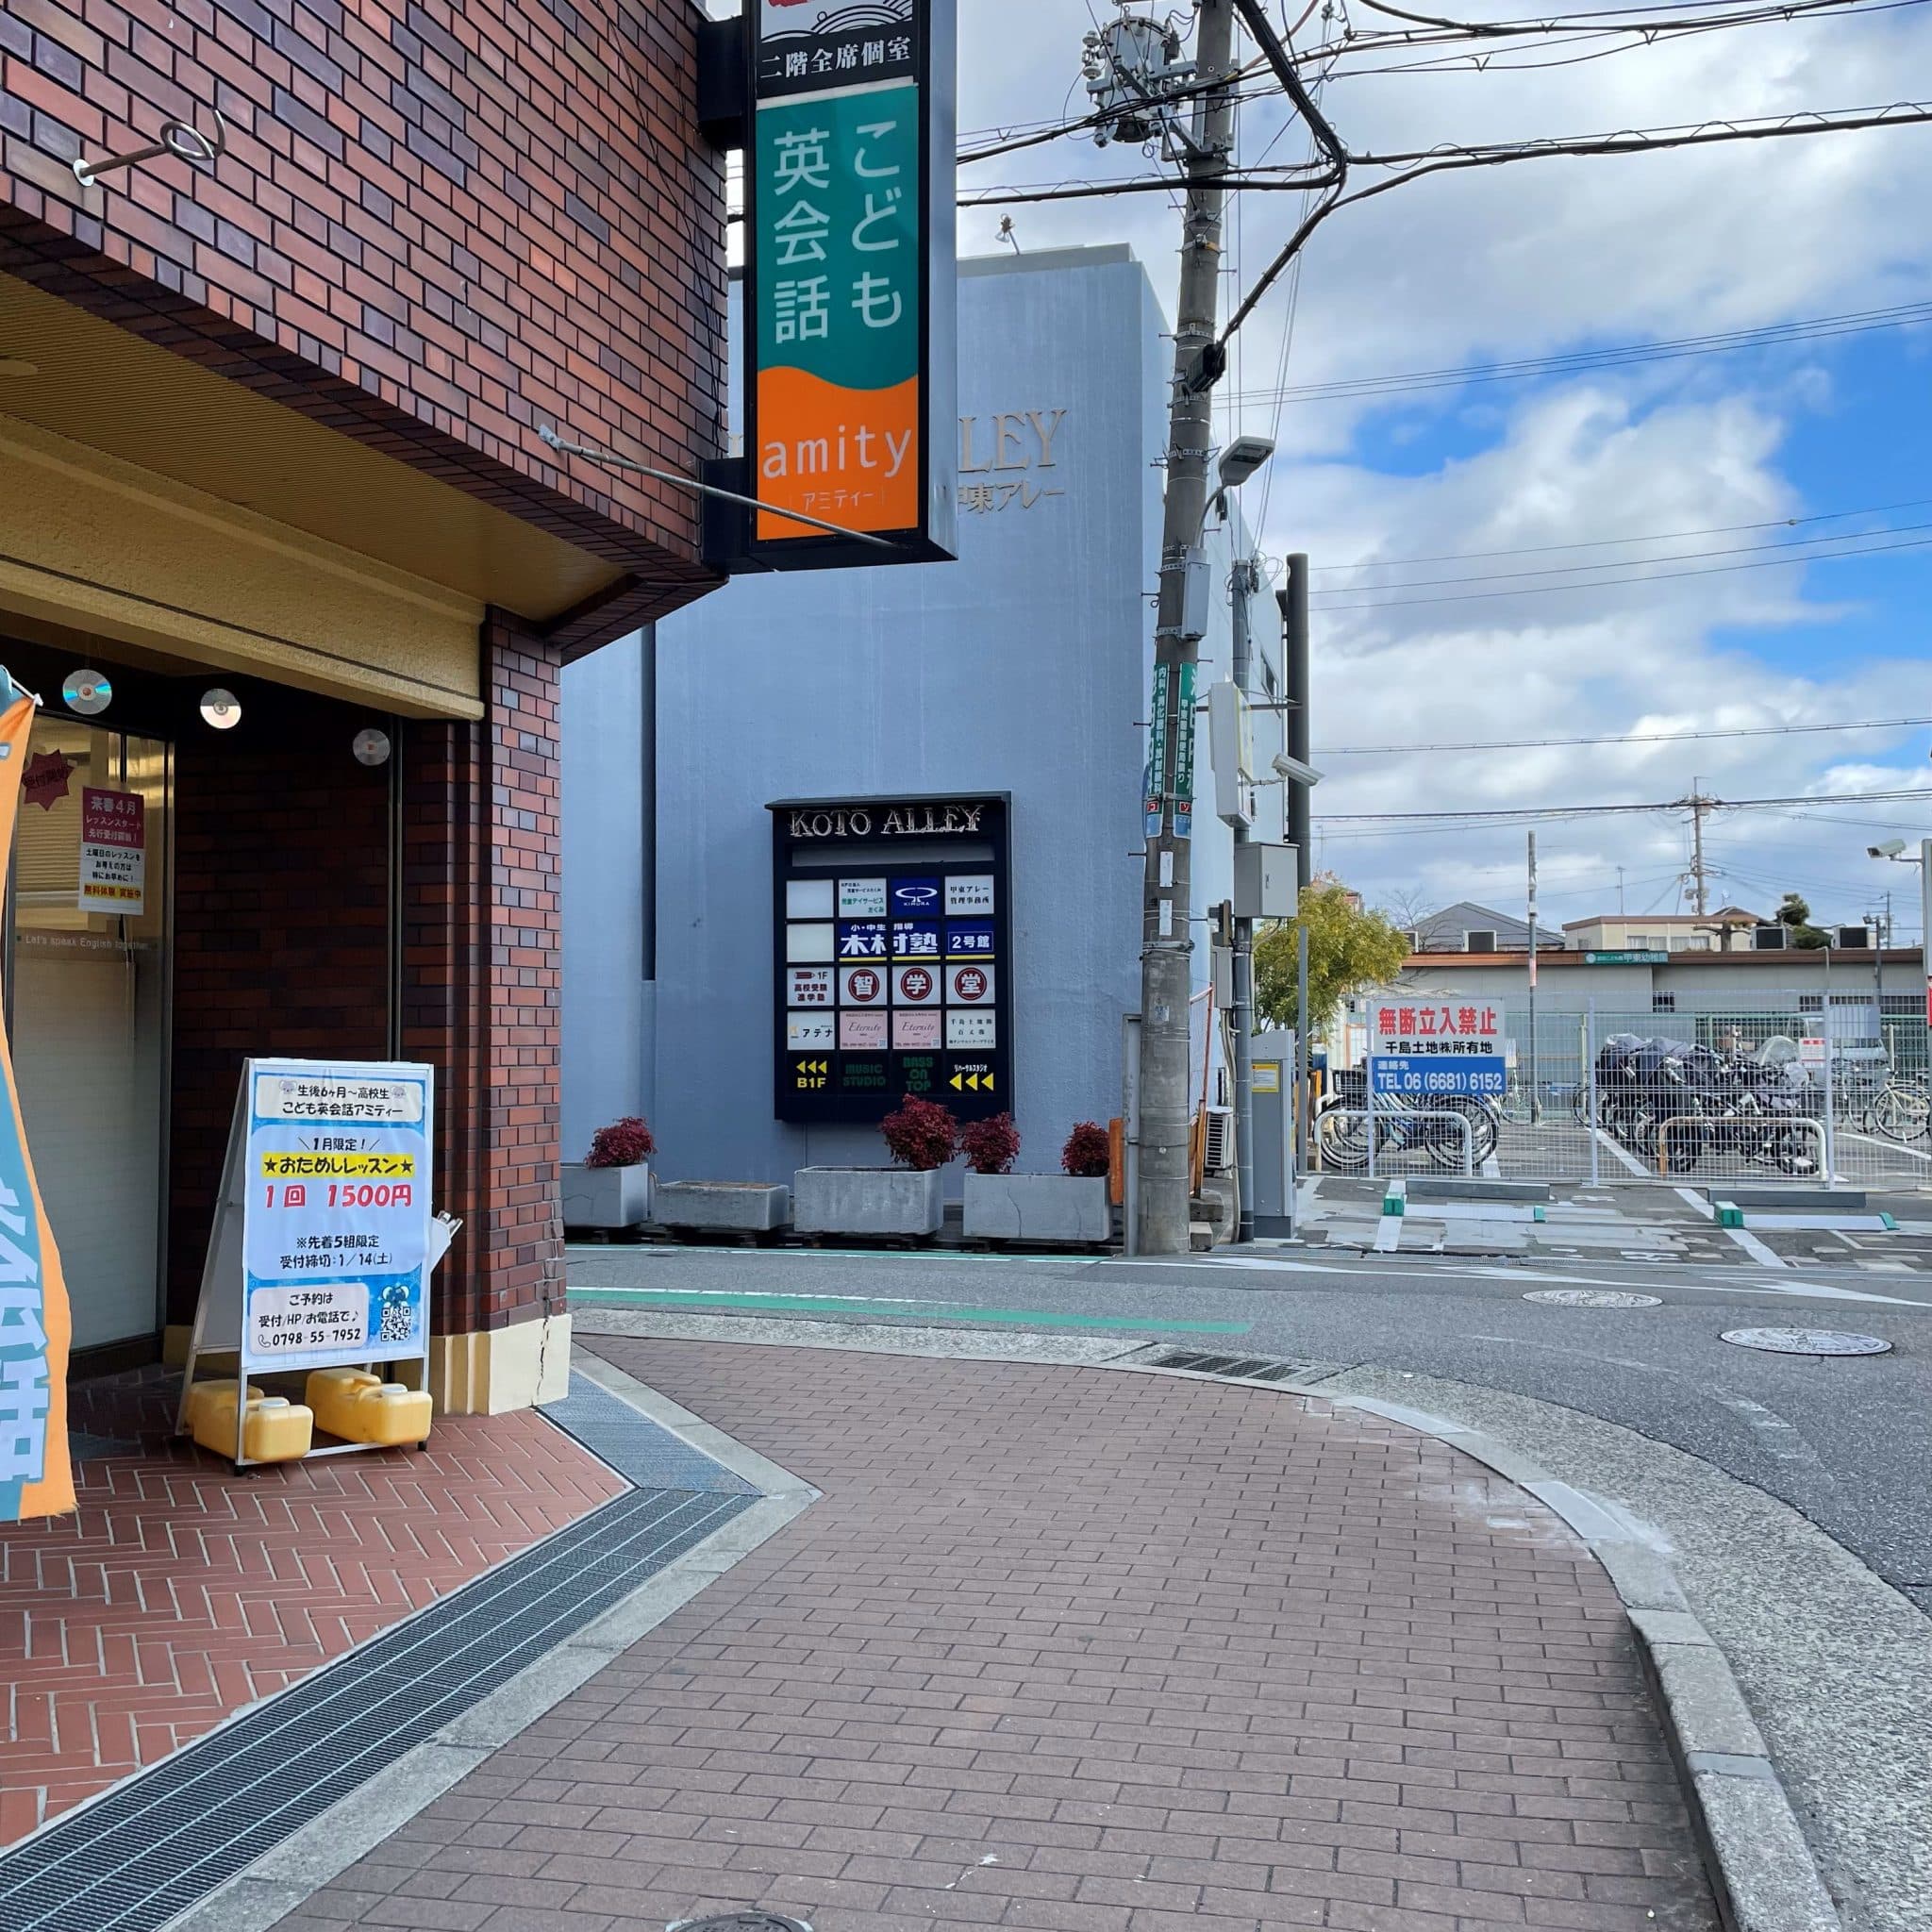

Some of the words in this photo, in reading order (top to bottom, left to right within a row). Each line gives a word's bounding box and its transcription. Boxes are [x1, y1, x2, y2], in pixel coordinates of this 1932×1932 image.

[760, 36, 911, 78] 二階全席個室
[852, 120, 903, 328] こども
[774, 126, 831, 344] 英会話
[958, 408, 1068, 474] LEY
[762, 424, 912, 478] amity
[804, 489, 874, 512] アミティー
[791, 809, 872, 837] KOTO
[880, 805, 985, 835] ALLEY
[952, 935, 990, 949] 2号館
[817, 972, 828, 980] 1F
[853, 974, 874, 996] 智
[906, 974, 926, 995] 学
[960, 973, 981, 994] 堂
[1378, 1007, 1498, 1036] 無断立入禁止
[803, 1028, 833, 1038] アテナ
[1386, 1041, 1493, 1055] 千島土地㈱所有地
[1377, 1059, 1410, 1071] 連絡先
[797, 1077, 826, 1088] B1F
[906, 1080, 932, 1092] TOP
[1377, 1073, 1402, 1091] TEL
[282, 1101, 404, 1117] こども英会話アミティー
[280, 1157, 398, 1174] おためしレッスン
[266, 1184, 306, 1208] 1回
[328, 1183, 412, 1208] 1500円
[289, 1291, 334, 1307] ご予約は
